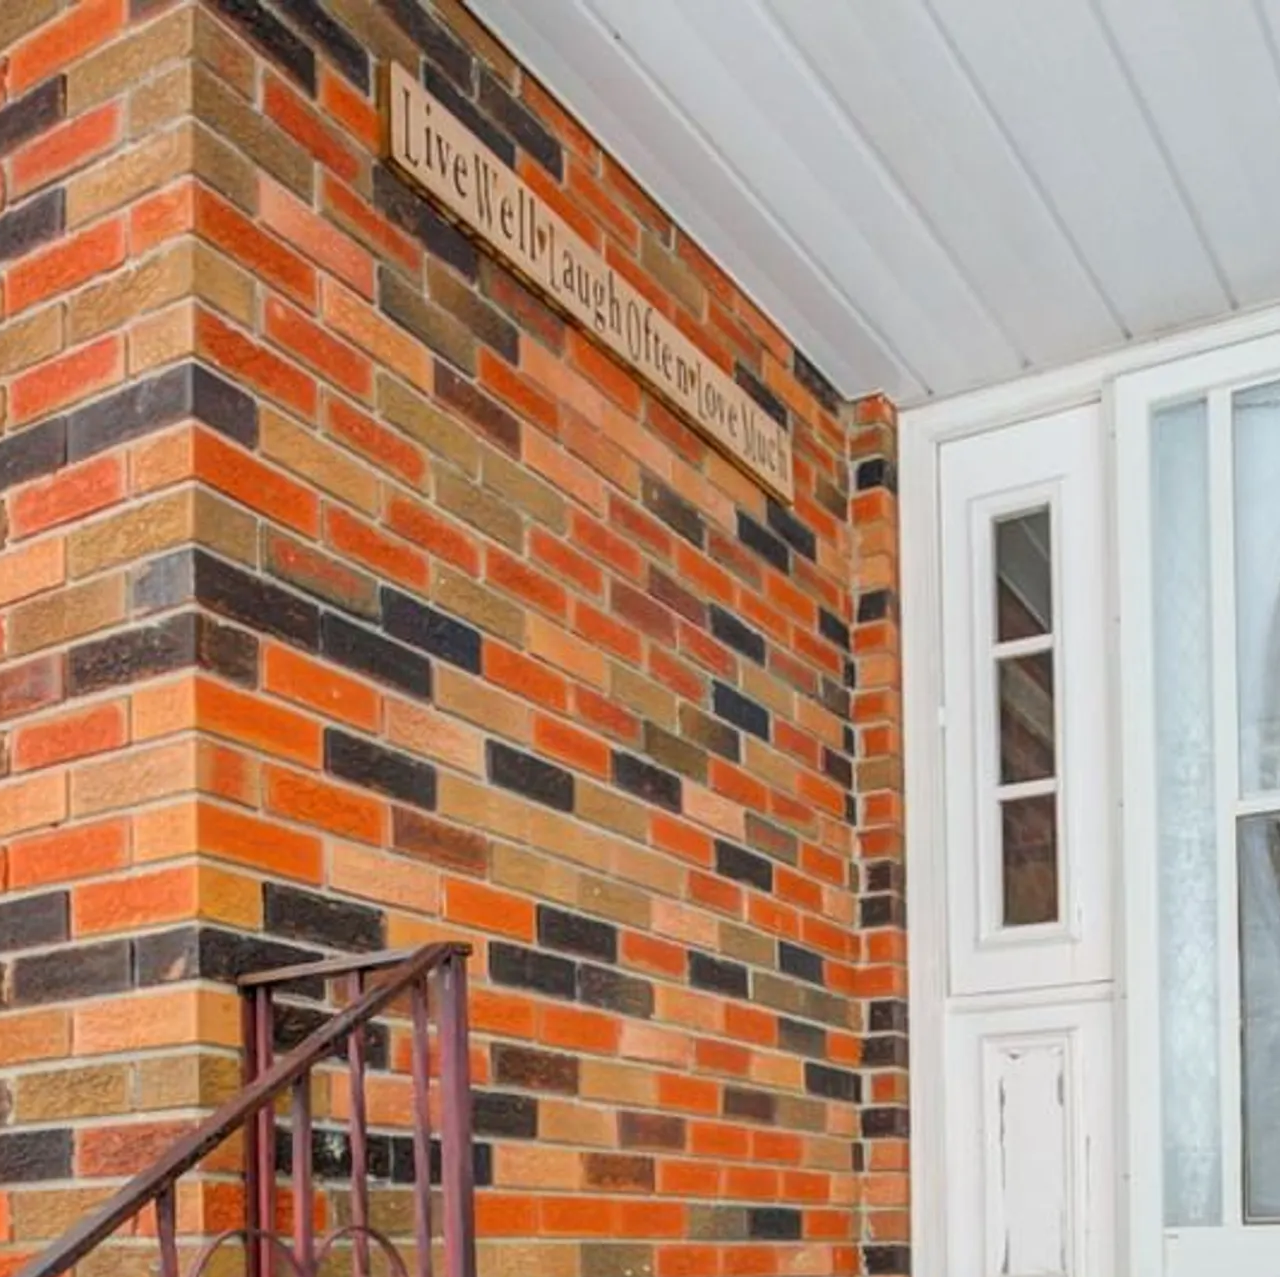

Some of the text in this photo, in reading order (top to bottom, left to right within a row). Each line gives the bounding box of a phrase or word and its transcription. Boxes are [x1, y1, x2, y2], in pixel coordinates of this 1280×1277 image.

[401, 86, 468, 199] Live
[473, 152, 536, 262] Well
[548, 222, 622, 336] Laugh
[626, 300, 690, 397] Often
[696, 358, 738, 438] Love
